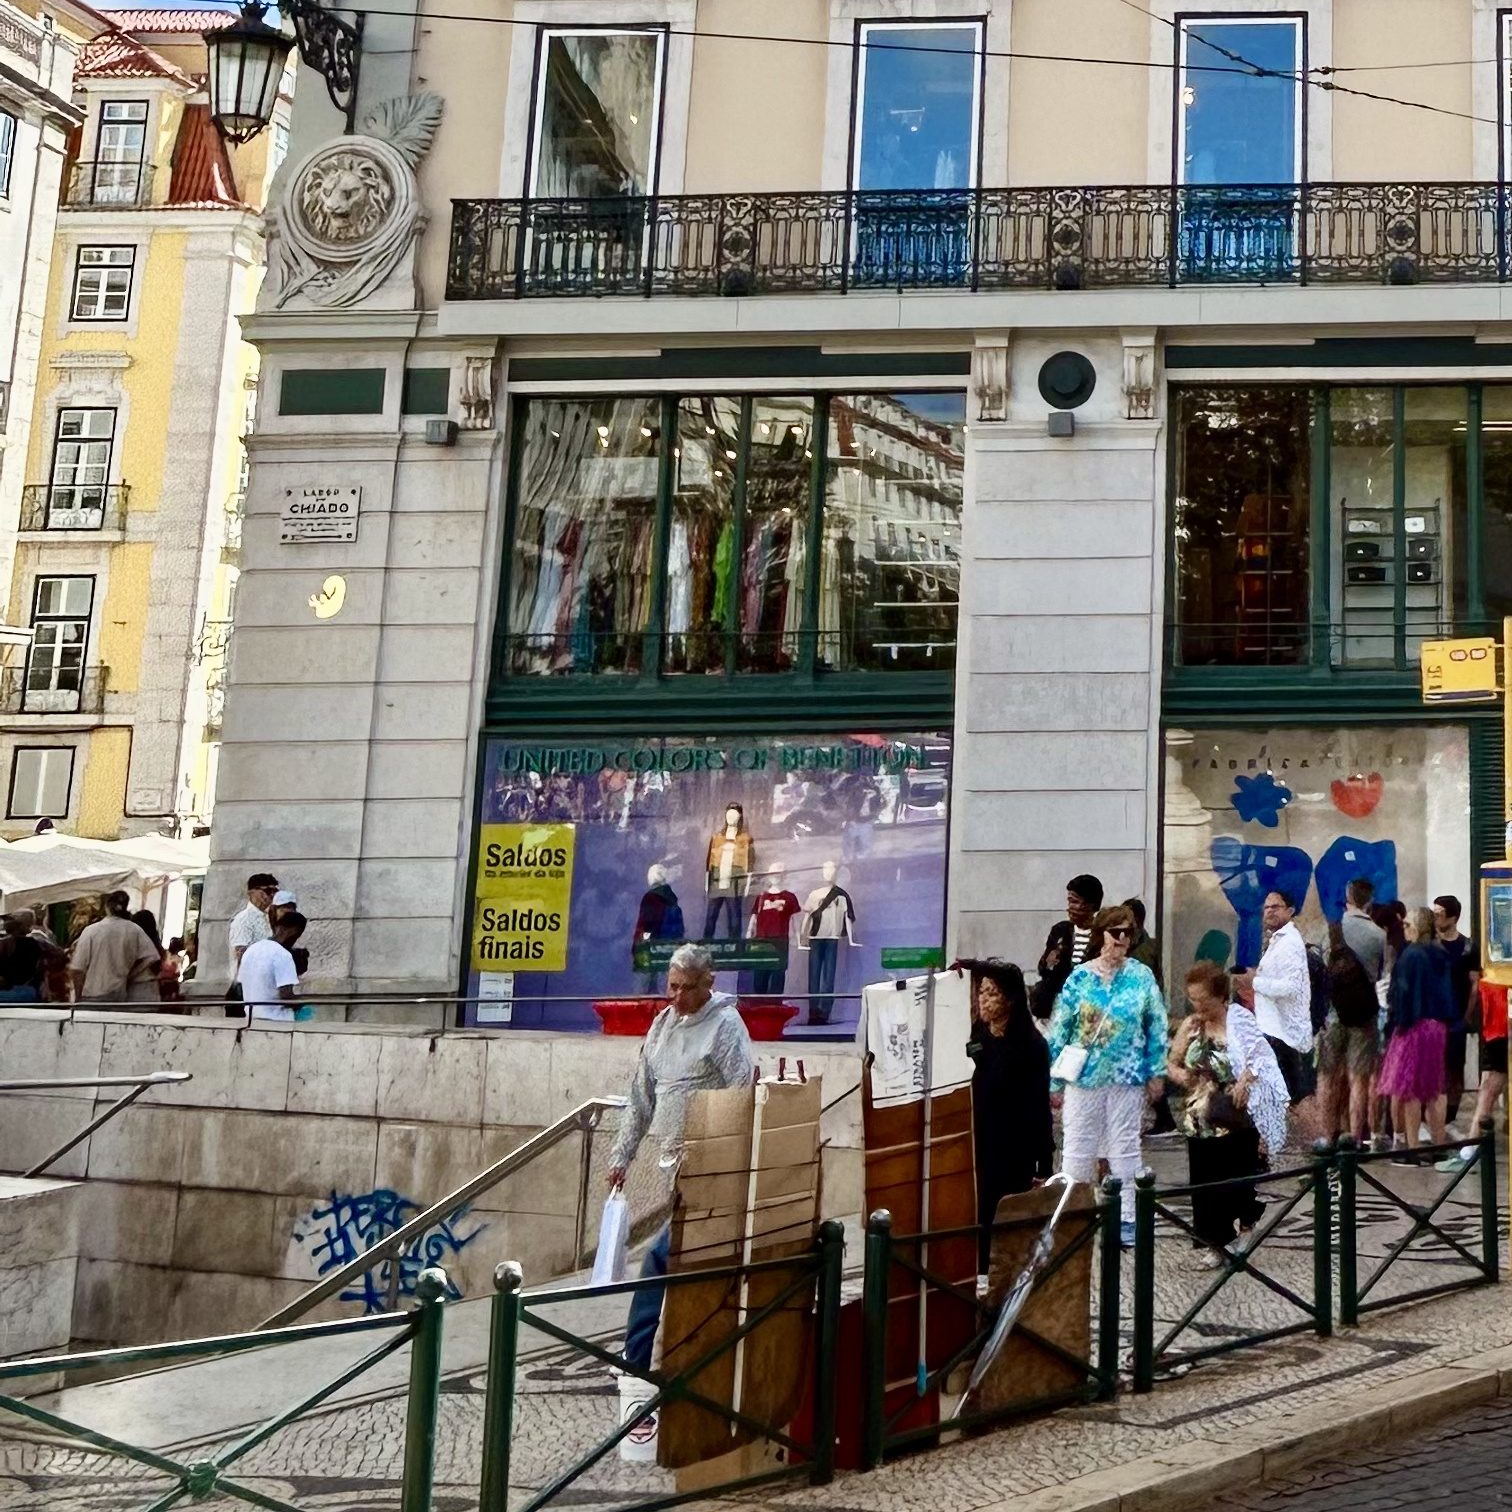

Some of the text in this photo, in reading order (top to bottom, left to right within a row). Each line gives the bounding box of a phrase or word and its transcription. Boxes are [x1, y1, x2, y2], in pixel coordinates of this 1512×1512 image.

[289, 502, 349, 514] CHIADO
[503, 748, 603, 774] UNITED
[615, 747, 726, 772] COLORS
[734, 746, 768, 771] OF
[486, 843, 566, 867] Saldos
[481, 908, 561, 932] Saldos
[479, 935, 544, 960] finais
